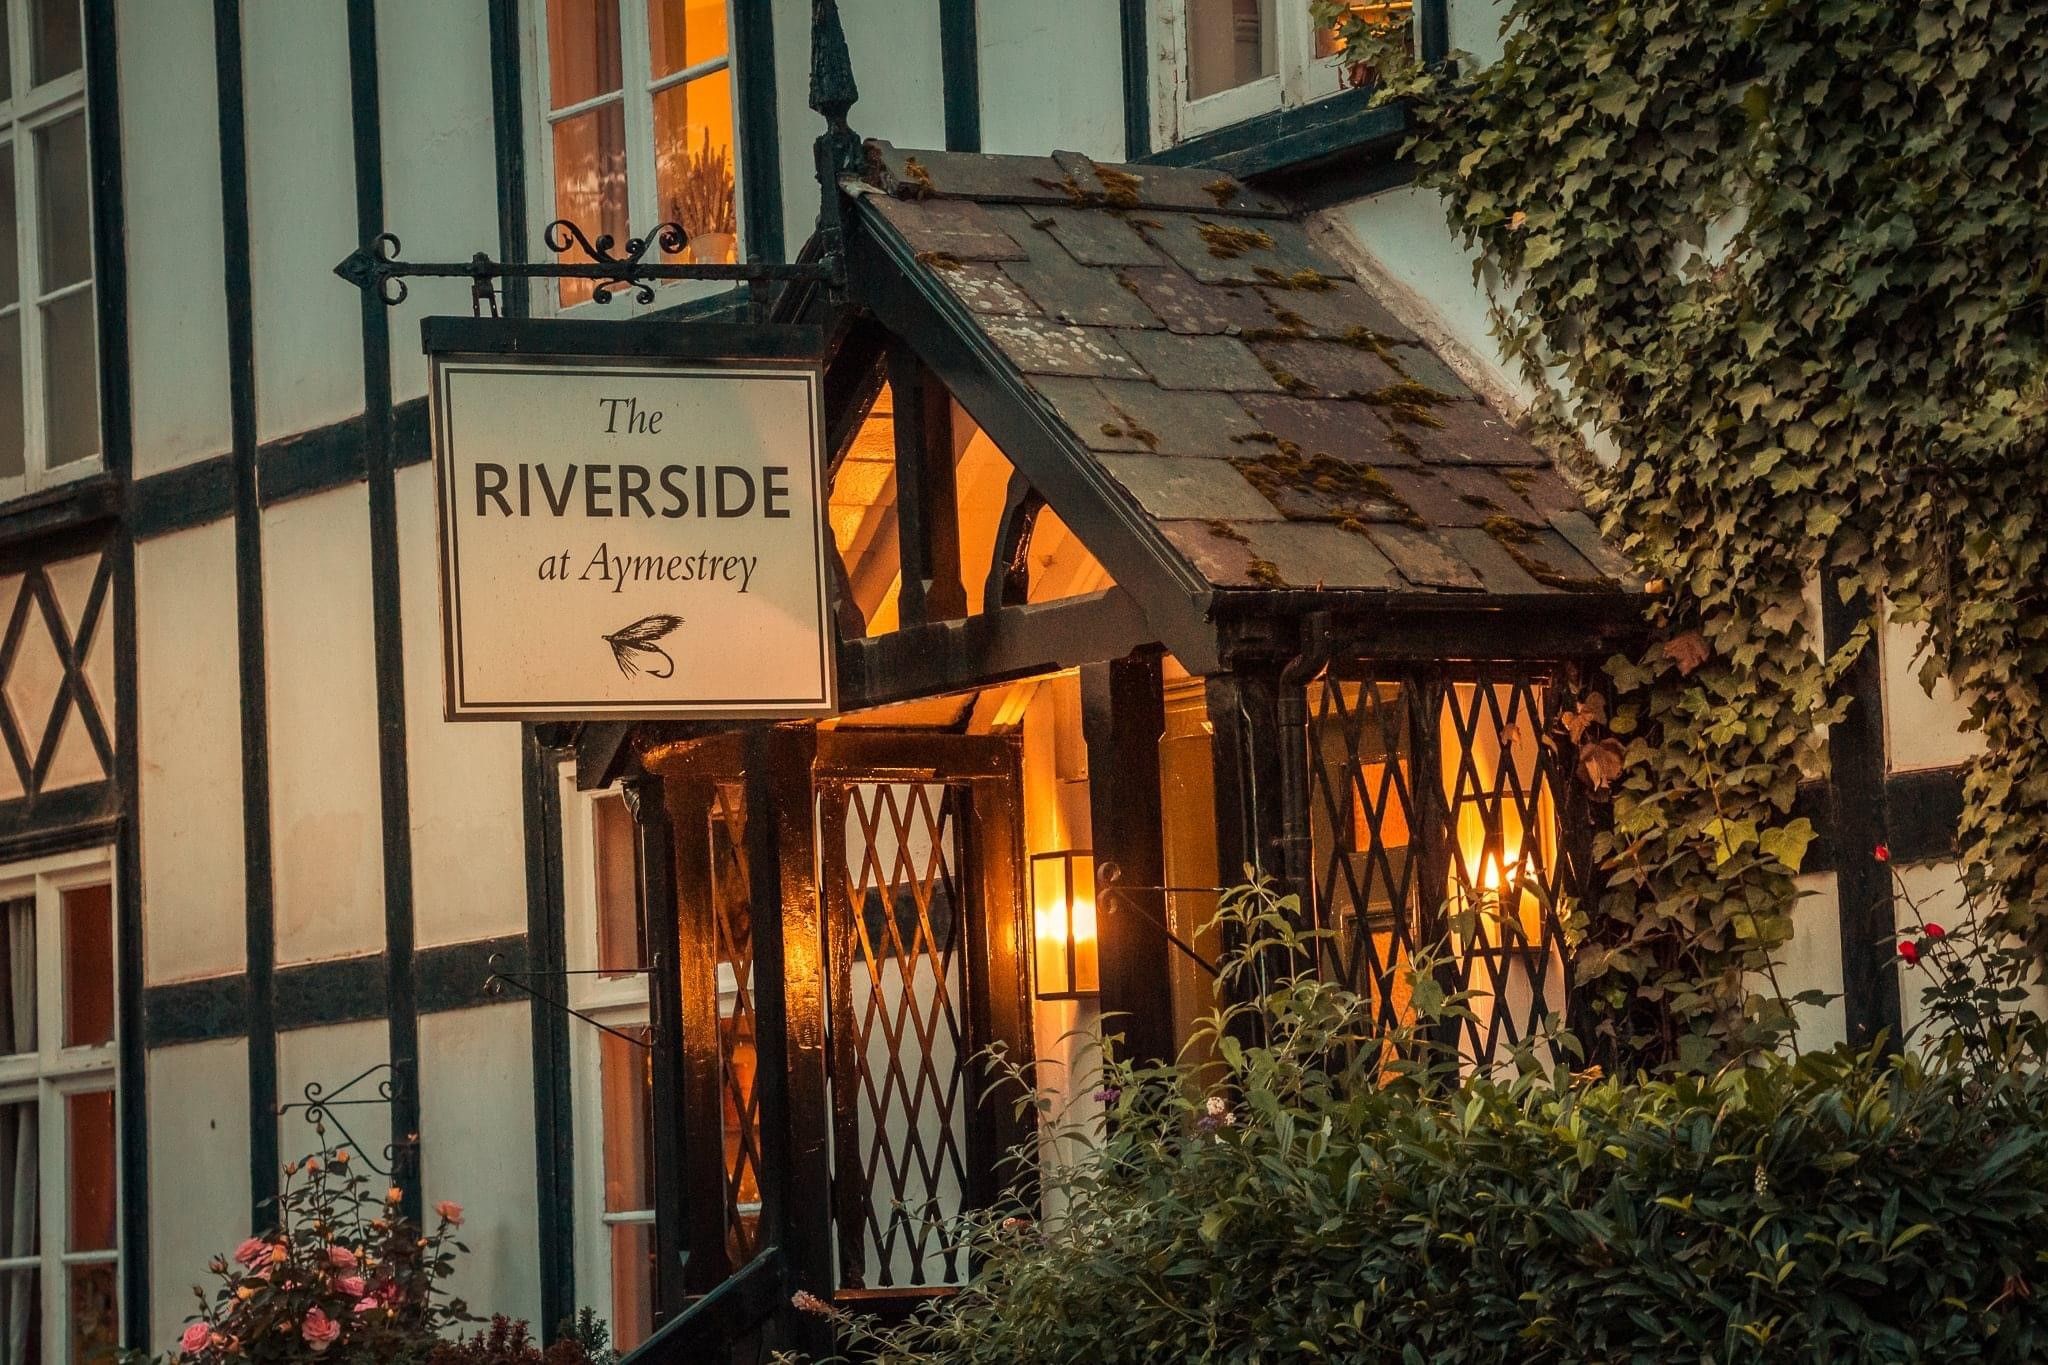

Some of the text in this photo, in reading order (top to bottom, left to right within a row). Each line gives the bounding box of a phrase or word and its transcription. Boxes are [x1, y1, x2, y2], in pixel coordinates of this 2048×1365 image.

[599, 397, 663, 435] The
[474, 462, 791, 519] RIVERSIDE
[537, 542, 758, 594] at Aymestrey
